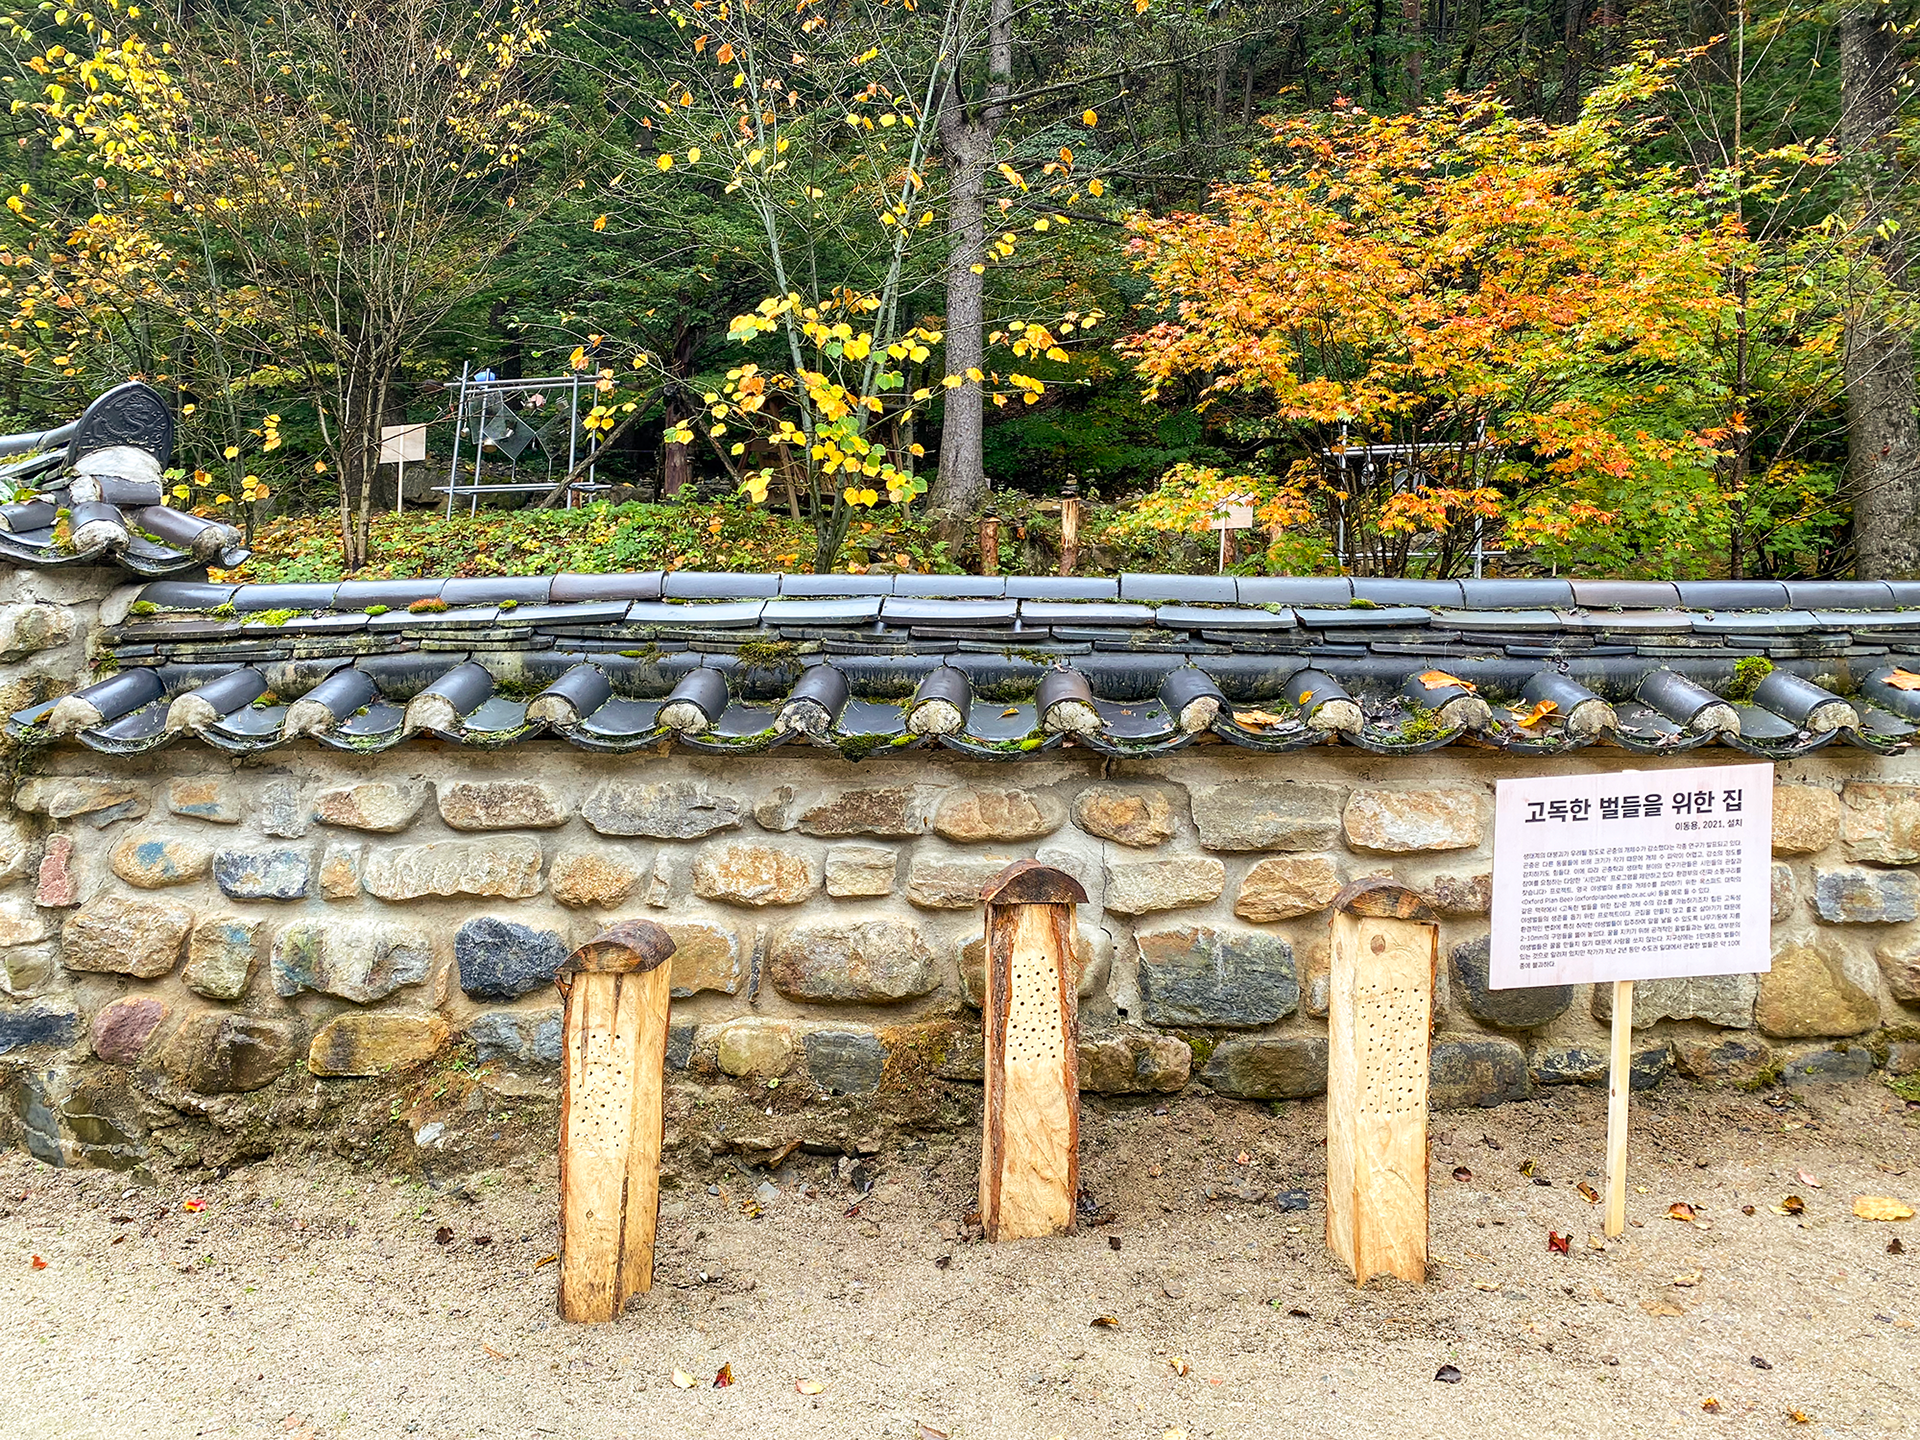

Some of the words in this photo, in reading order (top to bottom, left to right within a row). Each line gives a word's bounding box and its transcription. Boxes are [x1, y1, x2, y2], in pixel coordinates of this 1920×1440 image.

[1525, 798, 1591, 823] 고독한
[1600, 793, 1663, 820] 벌들을
[1671, 790, 1715, 814] 위한
[1722, 789, 1743, 812] 집
[1727, 818, 1743, 828] 설치
